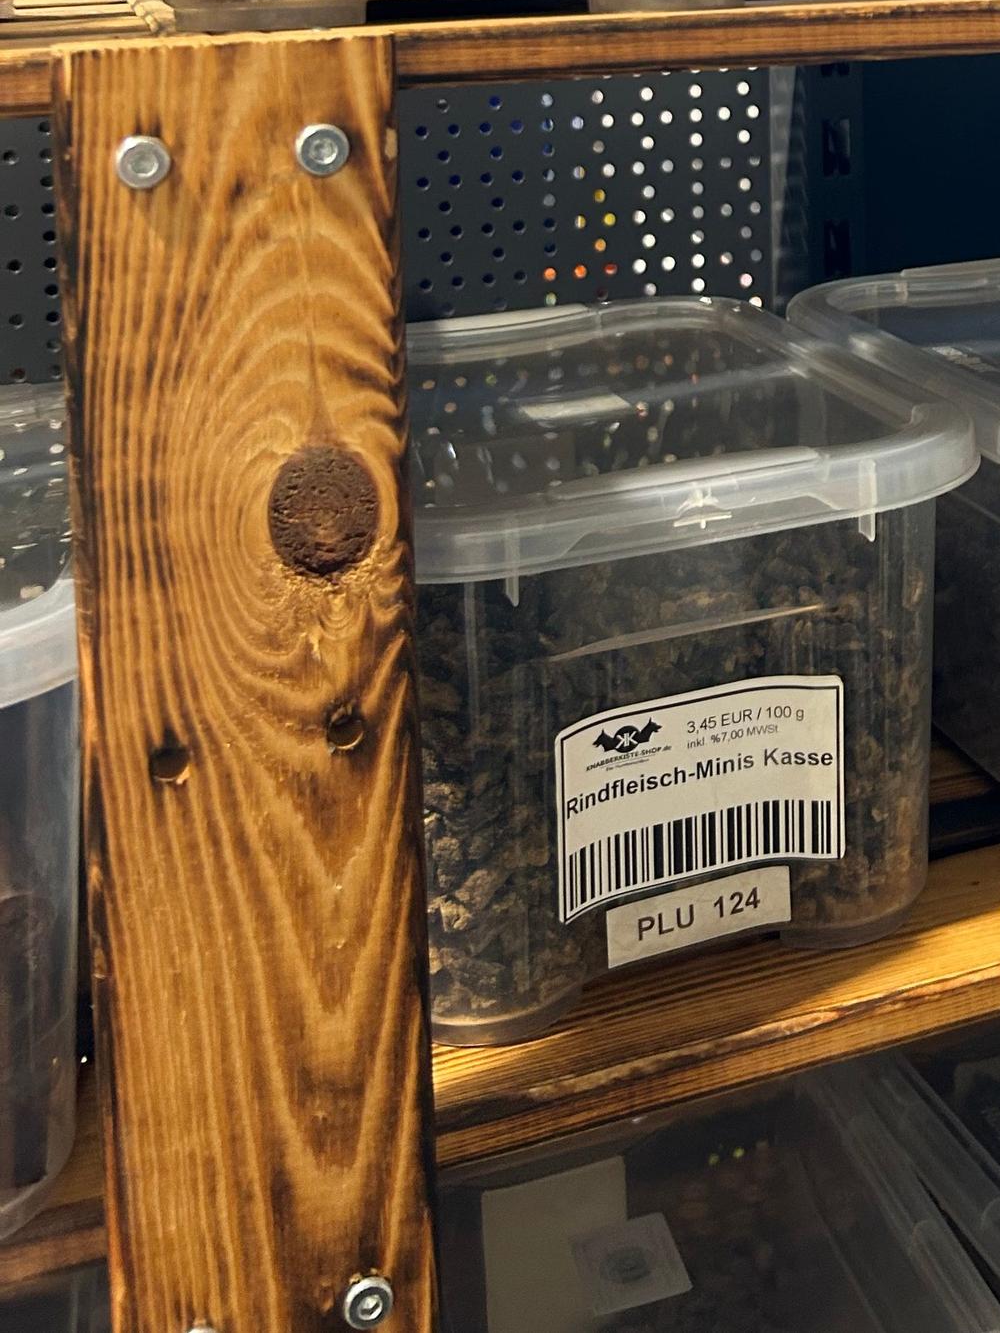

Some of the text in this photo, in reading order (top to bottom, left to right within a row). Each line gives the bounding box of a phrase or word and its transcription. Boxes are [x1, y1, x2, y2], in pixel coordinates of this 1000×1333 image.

[687, 716, 717, 734] 3,45
[721, 709, 753, 726] EUR
[766, 706, 792, 719] 100
[796, 709, 804, 721] g
[711, 729, 744, 744] %7,00
[566, 748, 833, 819] Rindfleisch-Minis Kasse
[637, 887, 761, 941] PLU 124
